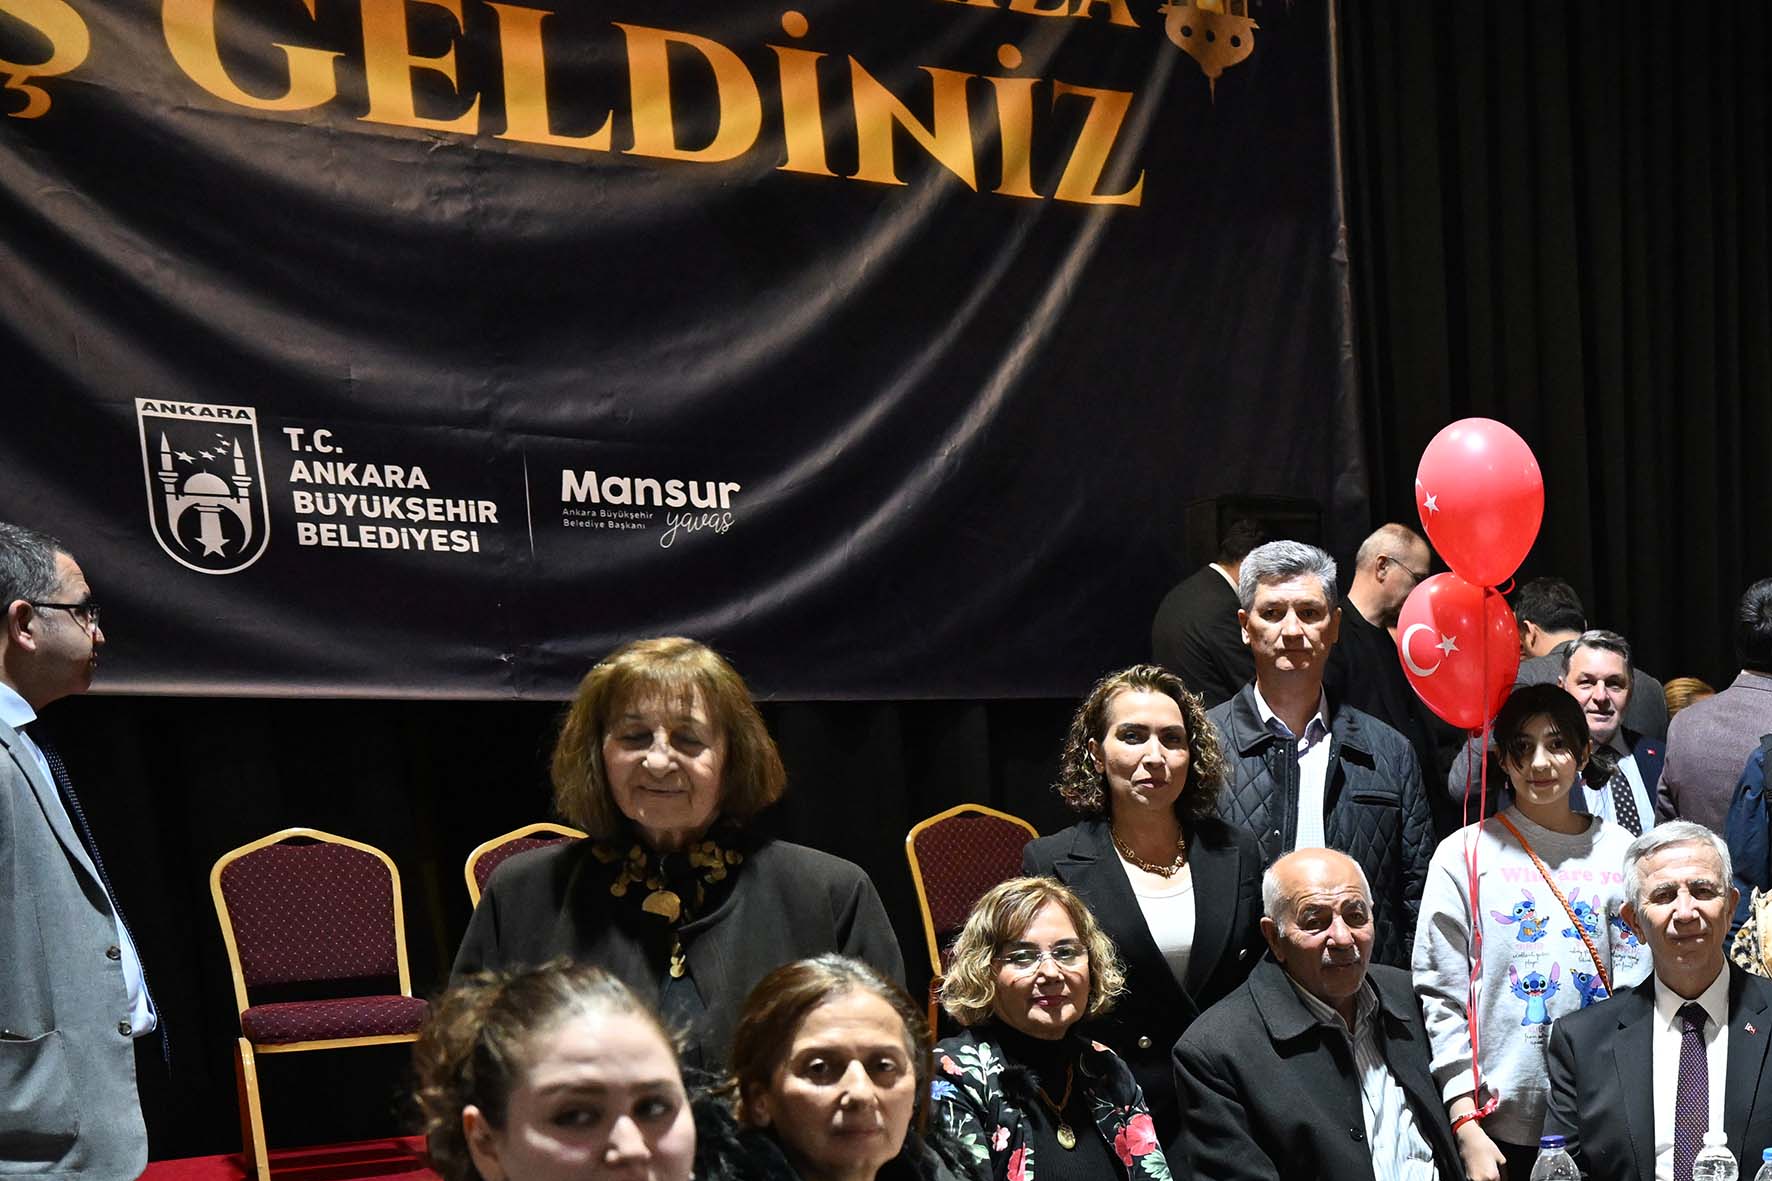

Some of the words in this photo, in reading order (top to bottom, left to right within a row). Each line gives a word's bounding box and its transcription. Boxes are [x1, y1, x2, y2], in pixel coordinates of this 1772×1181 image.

[162, 0, 1145, 207] GELDİNİZ
[141, 400, 252, 421] ANKARA
[282, 427, 344, 454] T.C.
[289, 459, 431, 490] ANKARA
[561, 469, 742, 509] Mansur
[292, 490, 499, 524] BÜYÜKŞEHİR
[562, 507, 598, 518] Ankara
[600, 509, 654, 520] Büyükşehir
[296, 521, 480, 554] BELEDİYESİ
[563, 518, 606, 530] Belediye
[608, 520, 647, 531] Başkanı
[1501, 867, 1545, 883] Wh
[1600, 871, 1624, 885] yo
